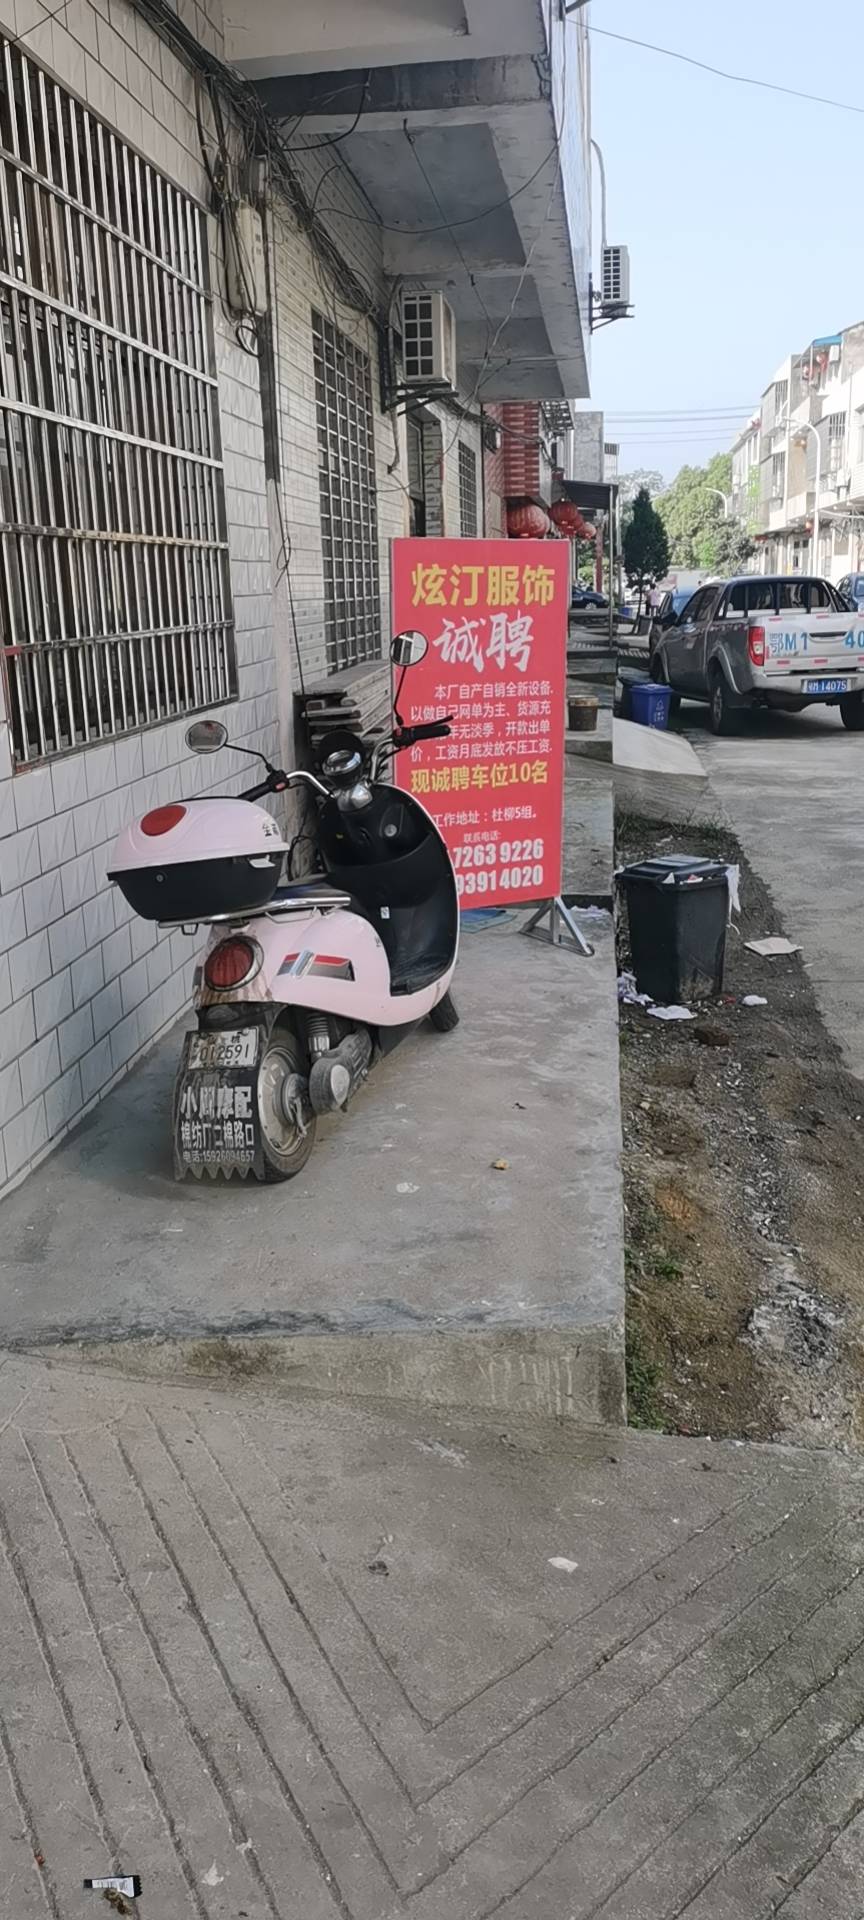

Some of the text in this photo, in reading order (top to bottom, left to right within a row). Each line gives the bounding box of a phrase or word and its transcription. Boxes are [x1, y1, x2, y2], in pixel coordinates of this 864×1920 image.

[411, 562, 555, 607] 炫汀服饰
[432, 609, 534, 673] 诚聘
[411, 759, 548, 793] 现诚聘车位10名
[500, 838, 544, 863] 9226
[500, 864, 544, 889] 4020
[181, 1120, 254, 1149] 棉纺厂二棉路口
